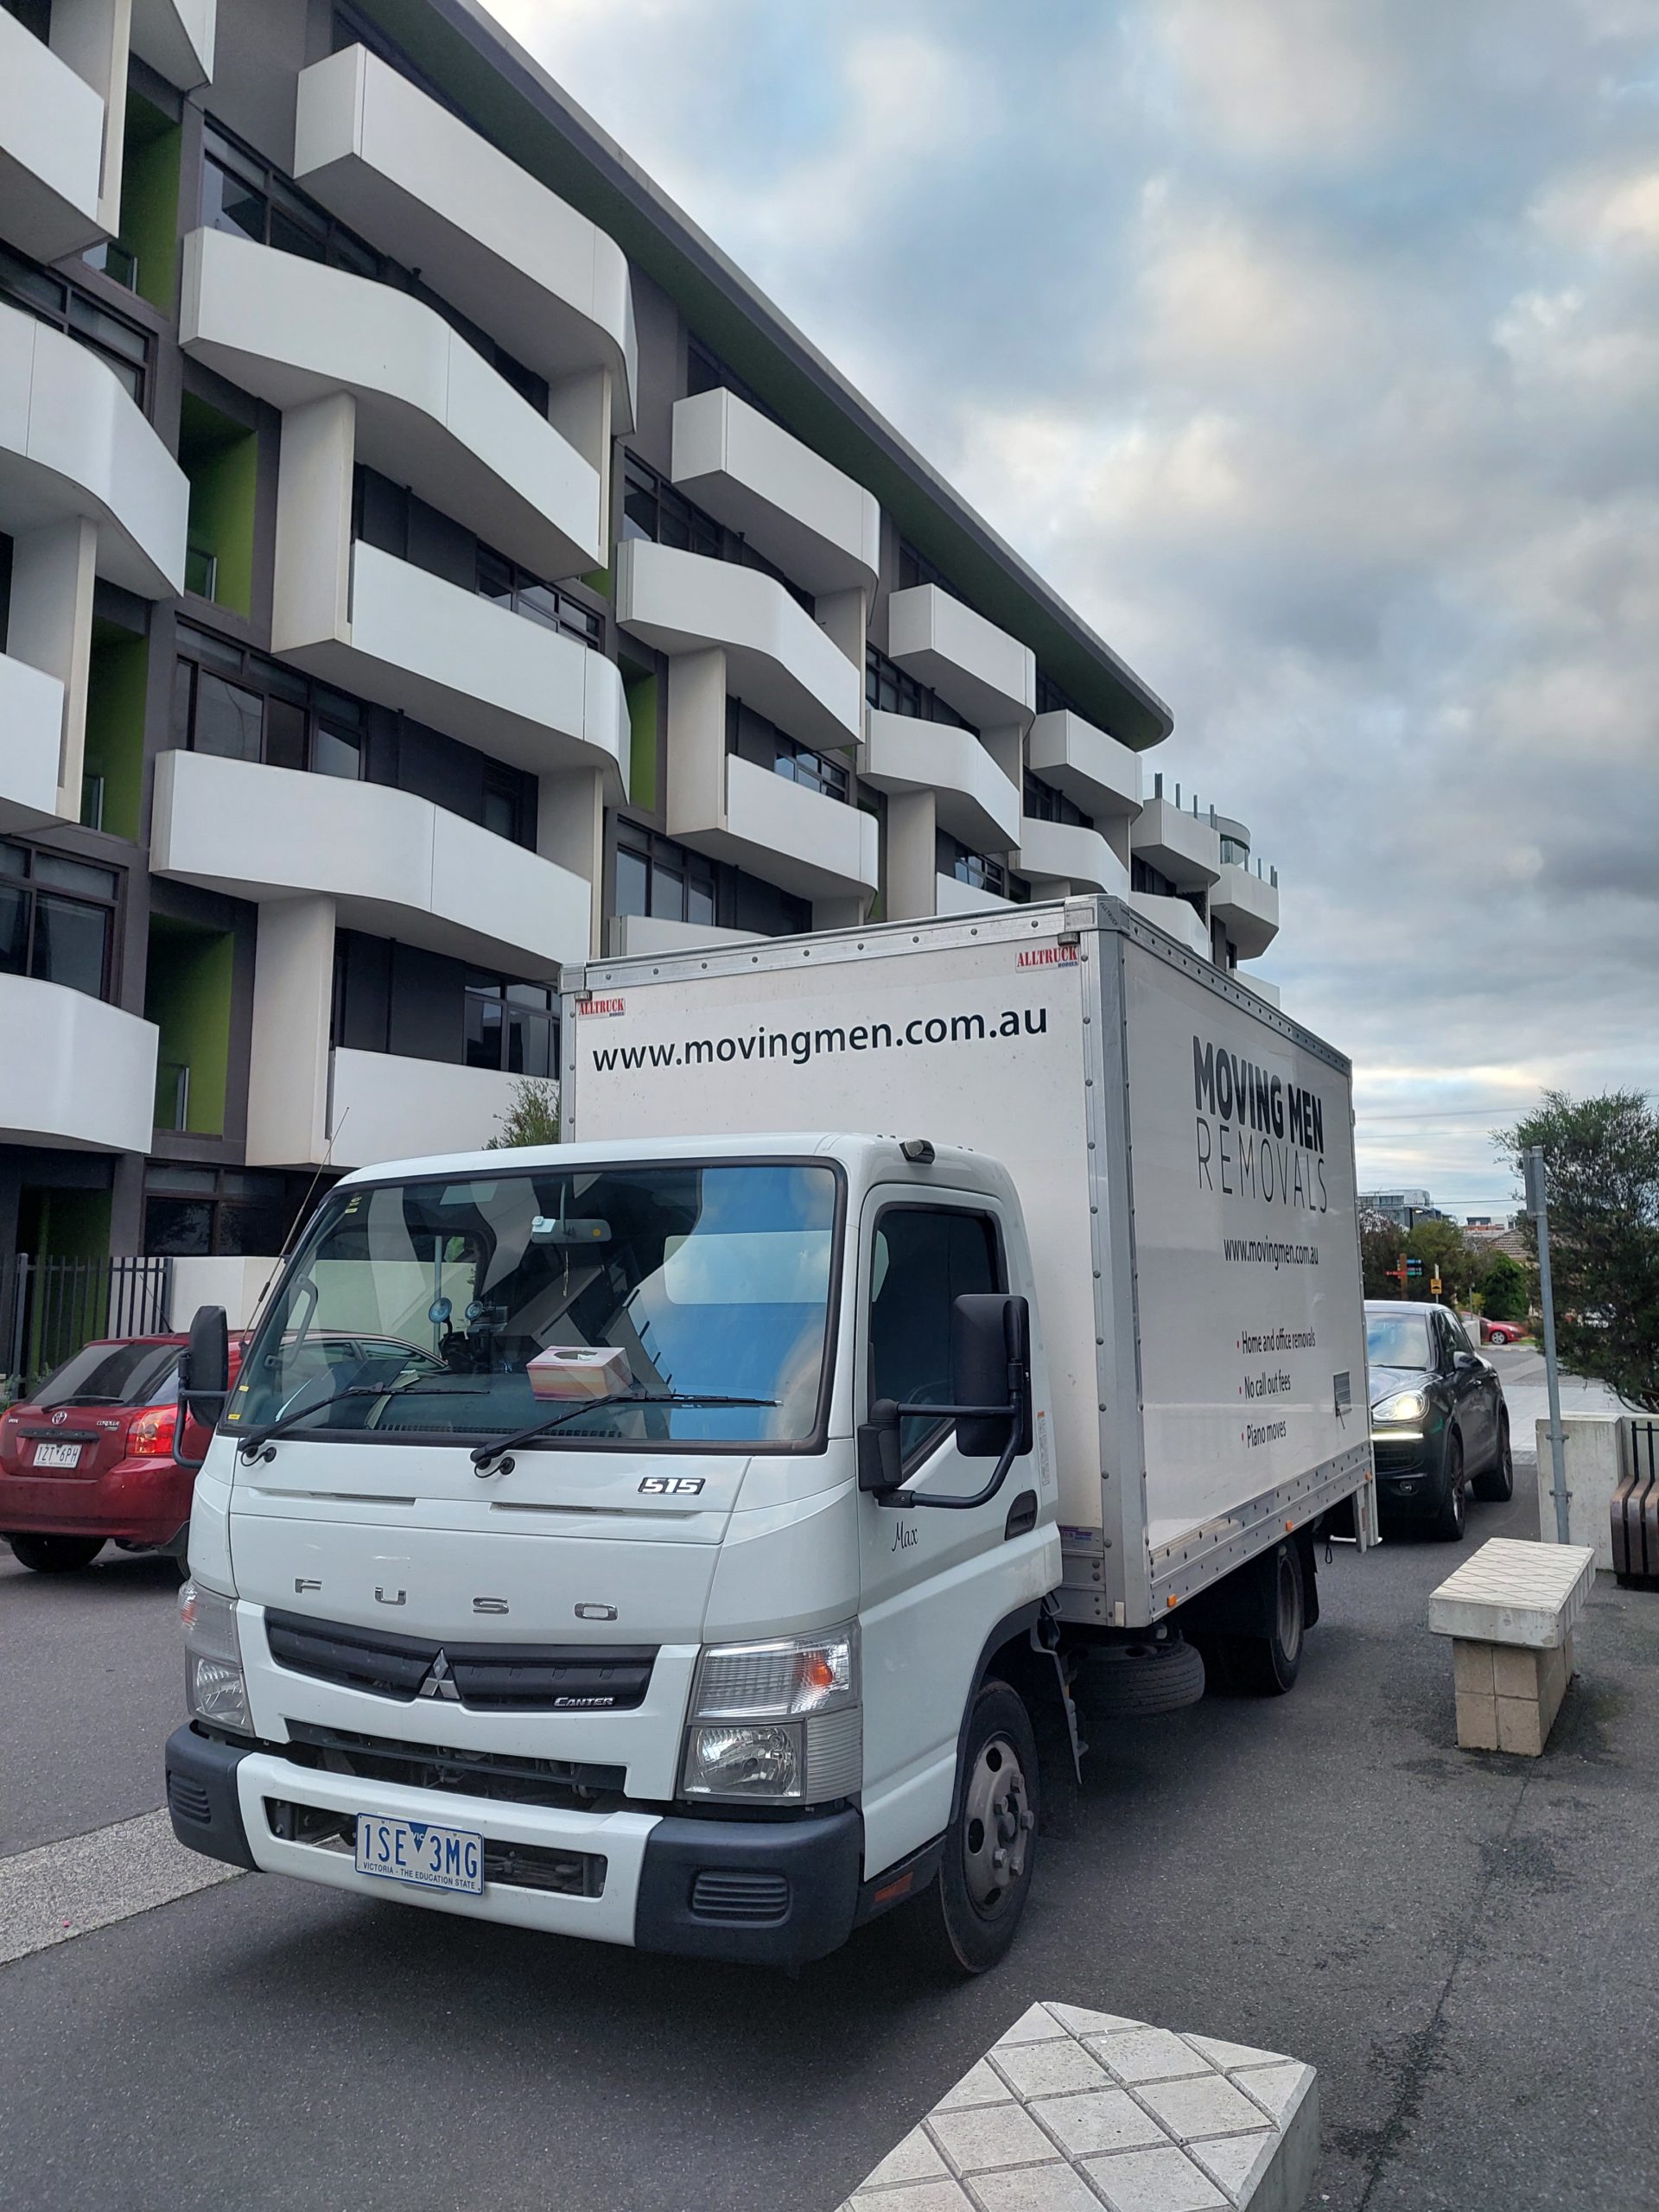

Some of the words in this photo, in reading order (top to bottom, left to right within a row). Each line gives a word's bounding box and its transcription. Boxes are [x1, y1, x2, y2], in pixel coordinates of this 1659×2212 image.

[1017, 945, 1077, 967] ALLTRUCK
[578, 998, 624, 1016] ALLTRUCK
[593, 1007, 1047, 1071] www.movingmen.com.au
[1193, 1035, 1284, 1139] MOVING
[1287, 1083, 1324, 1154] MEN
[1196, 1116, 1327, 1213] REMOVALS
[1224, 1235, 1319, 1271] www.movingmen.com.au
[1242, 1331, 1262, 1354] Home
[1262, 1328, 1274, 1352] and
[1276, 1327, 1292, 1351] office
[1292, 1326, 1316, 1349] removals
[1244, 1375, 1255, 1399] No
[1255, 1371, 1267, 1396] call
[1268, 1372, 1278, 1395] out
[1279, 1369, 1291, 1392] fees
[1246, 1423, 1266, 1449] Piano
[1267, 1421, 1287, 1442] moves
[37, 1446, 54, 1461] 1ZT
[60, 1447, 79, 1463] 6PH
[641, 1478, 702, 1494] 515
[891, 1520, 918, 1553] Max
[294, 1577, 619, 1621] FUSO
[554, 1696, 614, 1707] CANTER
[365, 1823, 407, 1866] 1SE
[429, 1835, 478, 1879] 3MG
[362, 1861, 394, 1874] VICTORIA
[400, 1868, 414, 1878] THE
[415, 1871, 454, 1885] EDUCATION
[454, 1878, 476, 1890] STATE
